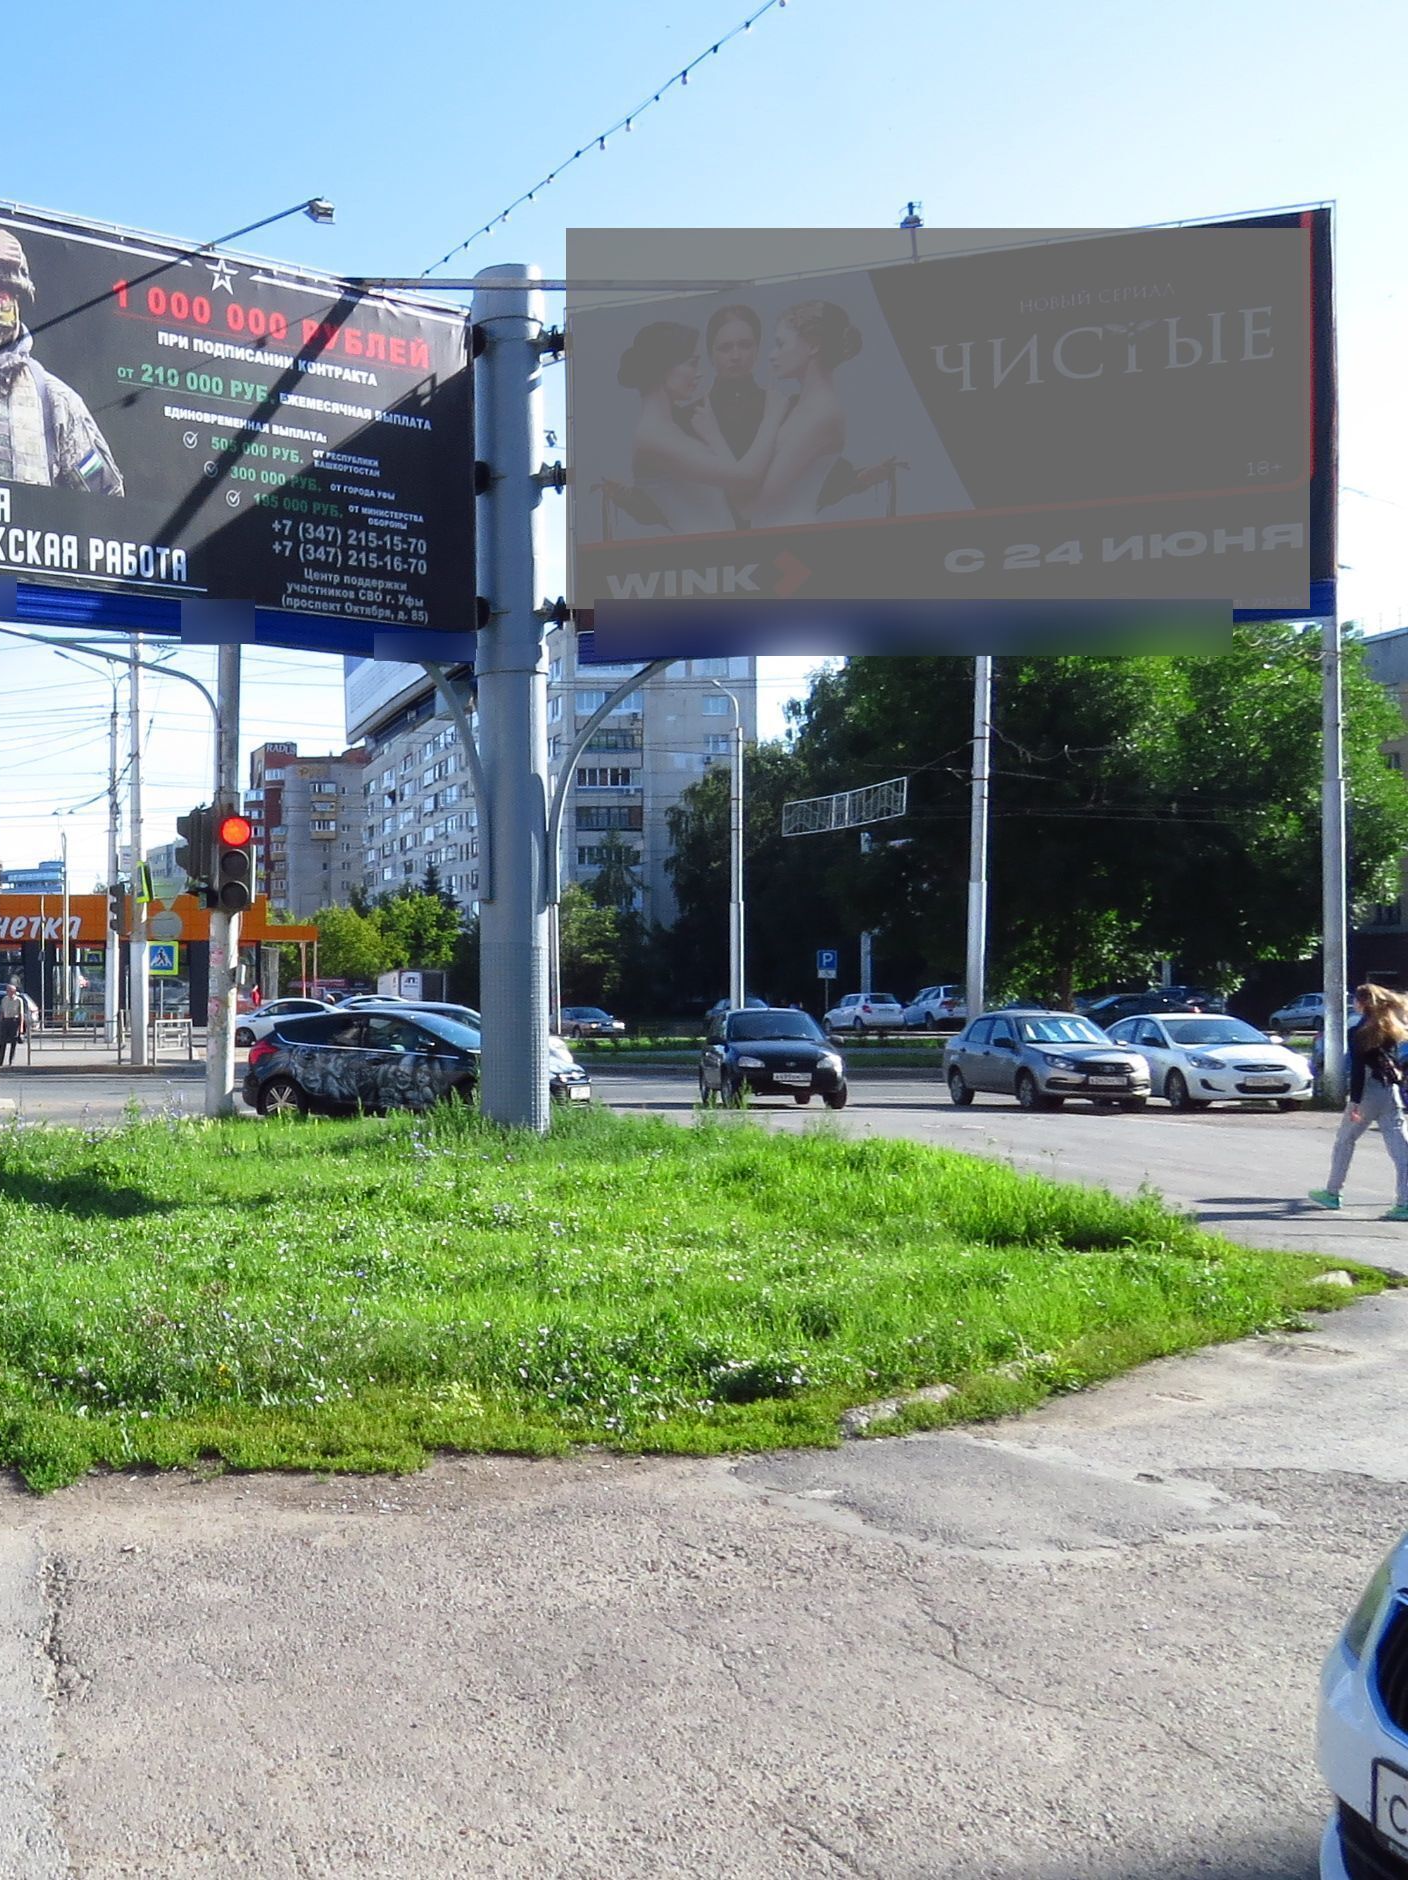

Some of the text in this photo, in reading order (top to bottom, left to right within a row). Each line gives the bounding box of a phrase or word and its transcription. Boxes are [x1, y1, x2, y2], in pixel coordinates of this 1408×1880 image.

[1019, 288, 1092, 314] НОВЫЙ
[112, 279, 430, 369] 1 000 000 РУБЛЕЙ
[158, 331, 378, 387] ПРИ ПОДПИСАНИИ КОНТРАКТА
[141, 363, 179, 388] 210
[186, 372, 223, 395] 000
[279, 392, 372, 421] ЕЖЕМЕСЯЧНАЯ
[375, 410, 432, 431] ВЫПЛАТА
[164, 405, 327, 443] ЕДИНОВРЕМЕННАЯ ВЫПЛАТА:
[211, 436, 304, 464] 505 000 РУБ.
[326, 451, 379, 467] РЕСПУБЛИКИ
[231, 466, 322, 492] 300 000 РУБ.
[314, 460, 380, 477] БАШКОРТОСТАН
[1246, 460, 1283, 478] 18+
[330, 483, 396, 500] ОТ ГОРОДА УФЫ
[253, 493, 343, 518] 195 000 РУБ.
[348, 505, 424, 523] ОТ МИНИСТЕРСТВА
[272, 519, 427, 555] +7 (347) 215-15-70
[368, 518, 408, 530] ОБОРОНЫ
[89, 537, 187, 582] РАБОТА
[272, 541, 427, 575] +7 (347) 215-16-70
[944, 523, 1303, 573] С 24 ИЮНЯ
[304, 568, 407, 591] Центр поддержки
[606, 564, 761, 600] WINK
[286, 582, 424, 609] участников СВО г. Уфы
[281, 594, 341, 612] (проспект
[345, 602, 394, 620] Октября,
[412, 610, 429, 625] 85)
